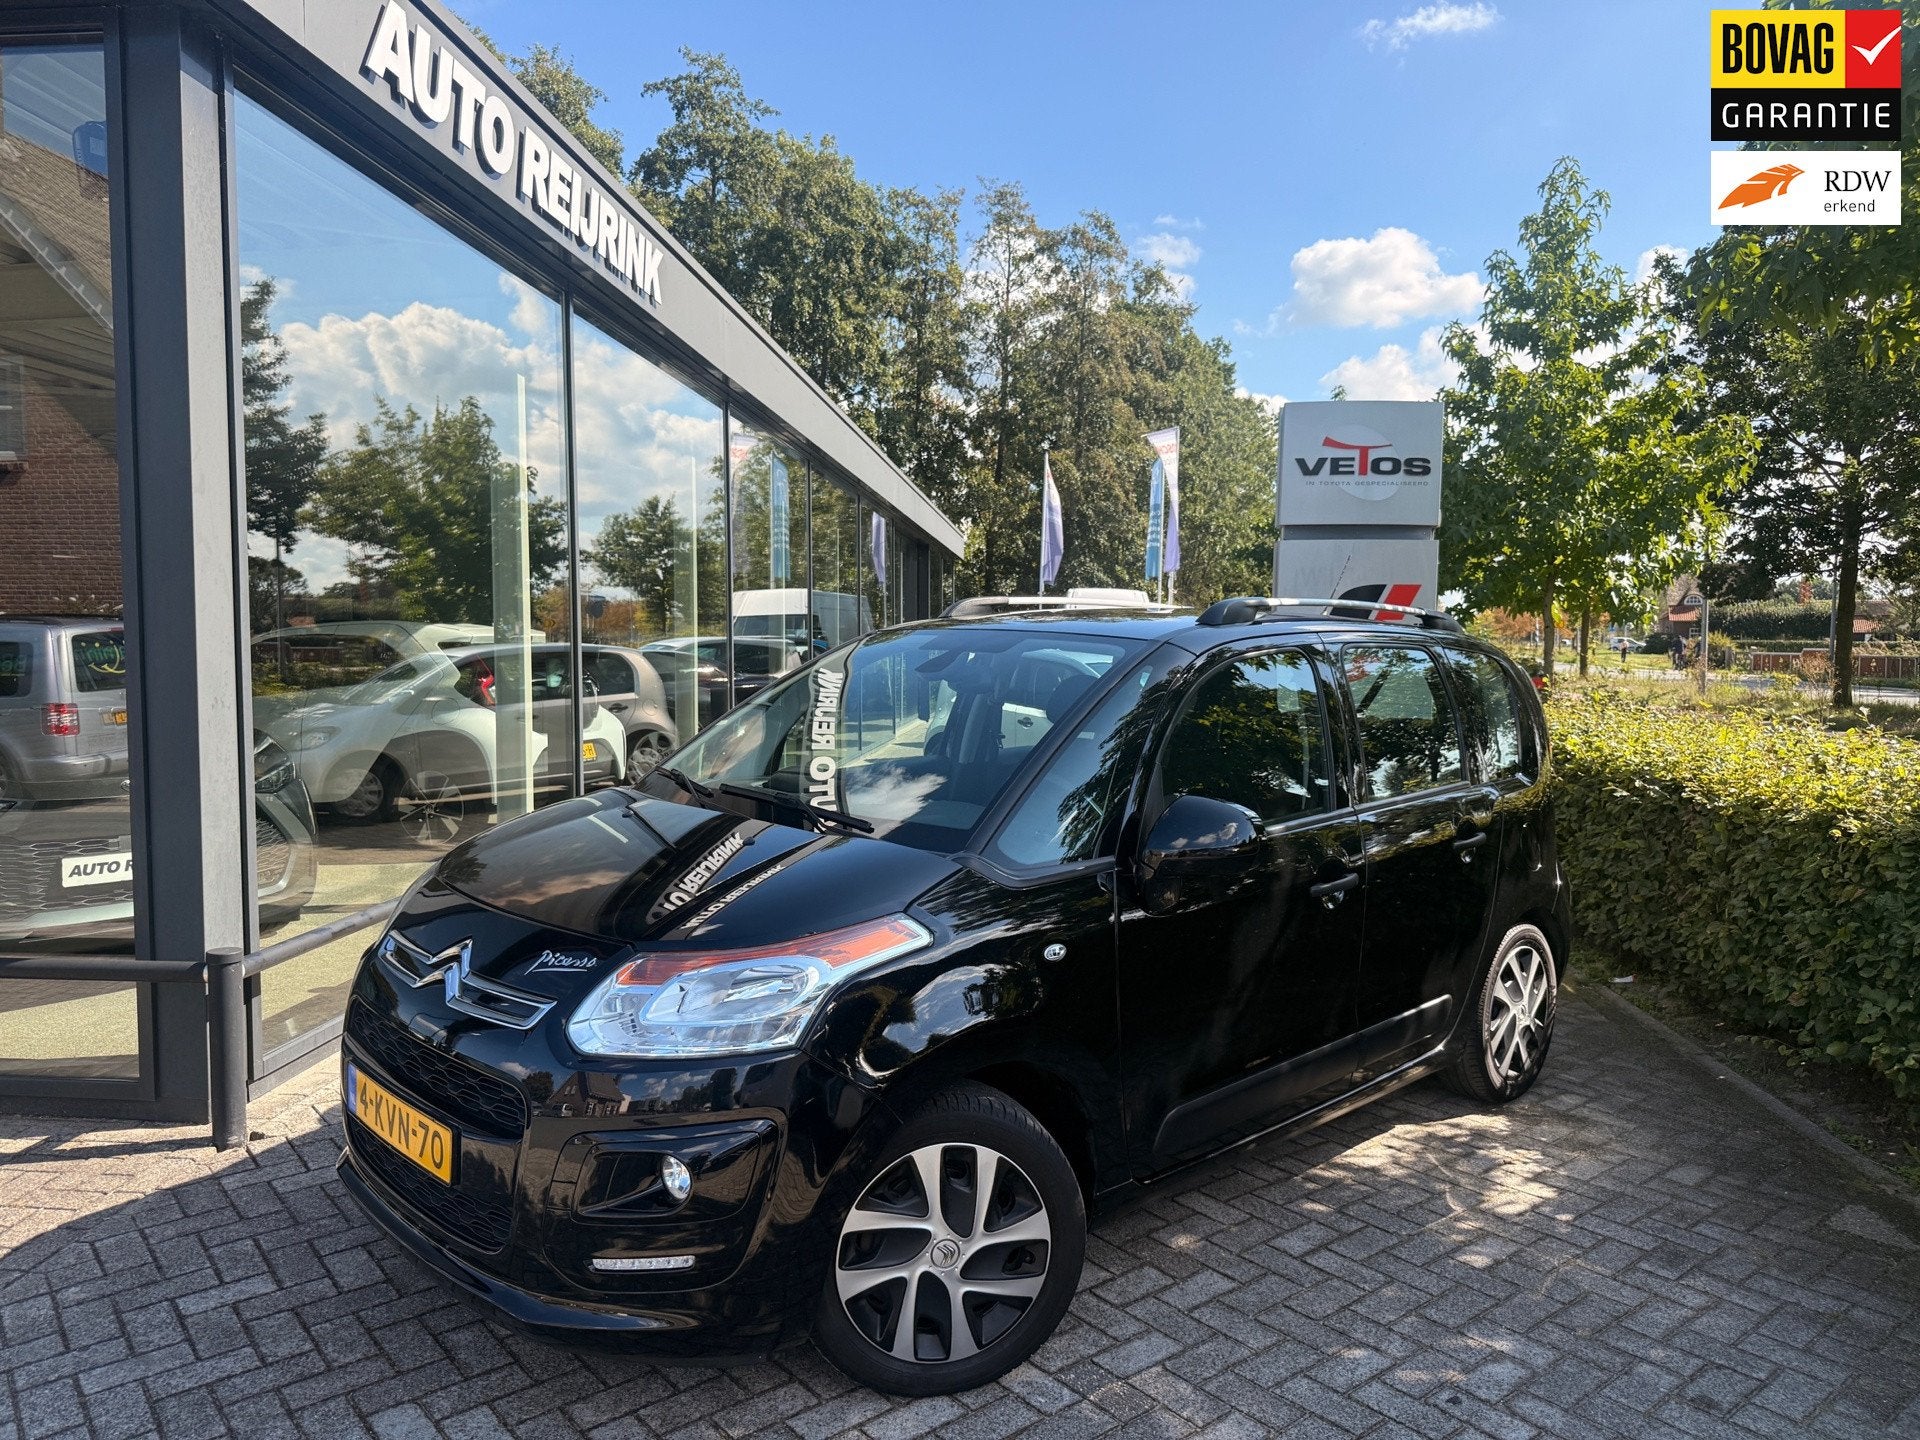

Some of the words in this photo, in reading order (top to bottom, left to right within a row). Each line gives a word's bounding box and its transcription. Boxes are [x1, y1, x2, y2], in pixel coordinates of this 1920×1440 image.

[364, 0, 515, 176] AUTO
[1294, 436, 1432, 477] VETOS
[68, 860, 121, 878] AUTO
[524, 949, 598, 976] Picasso
[359, 1081, 445, 1171] 4-KVN-70
